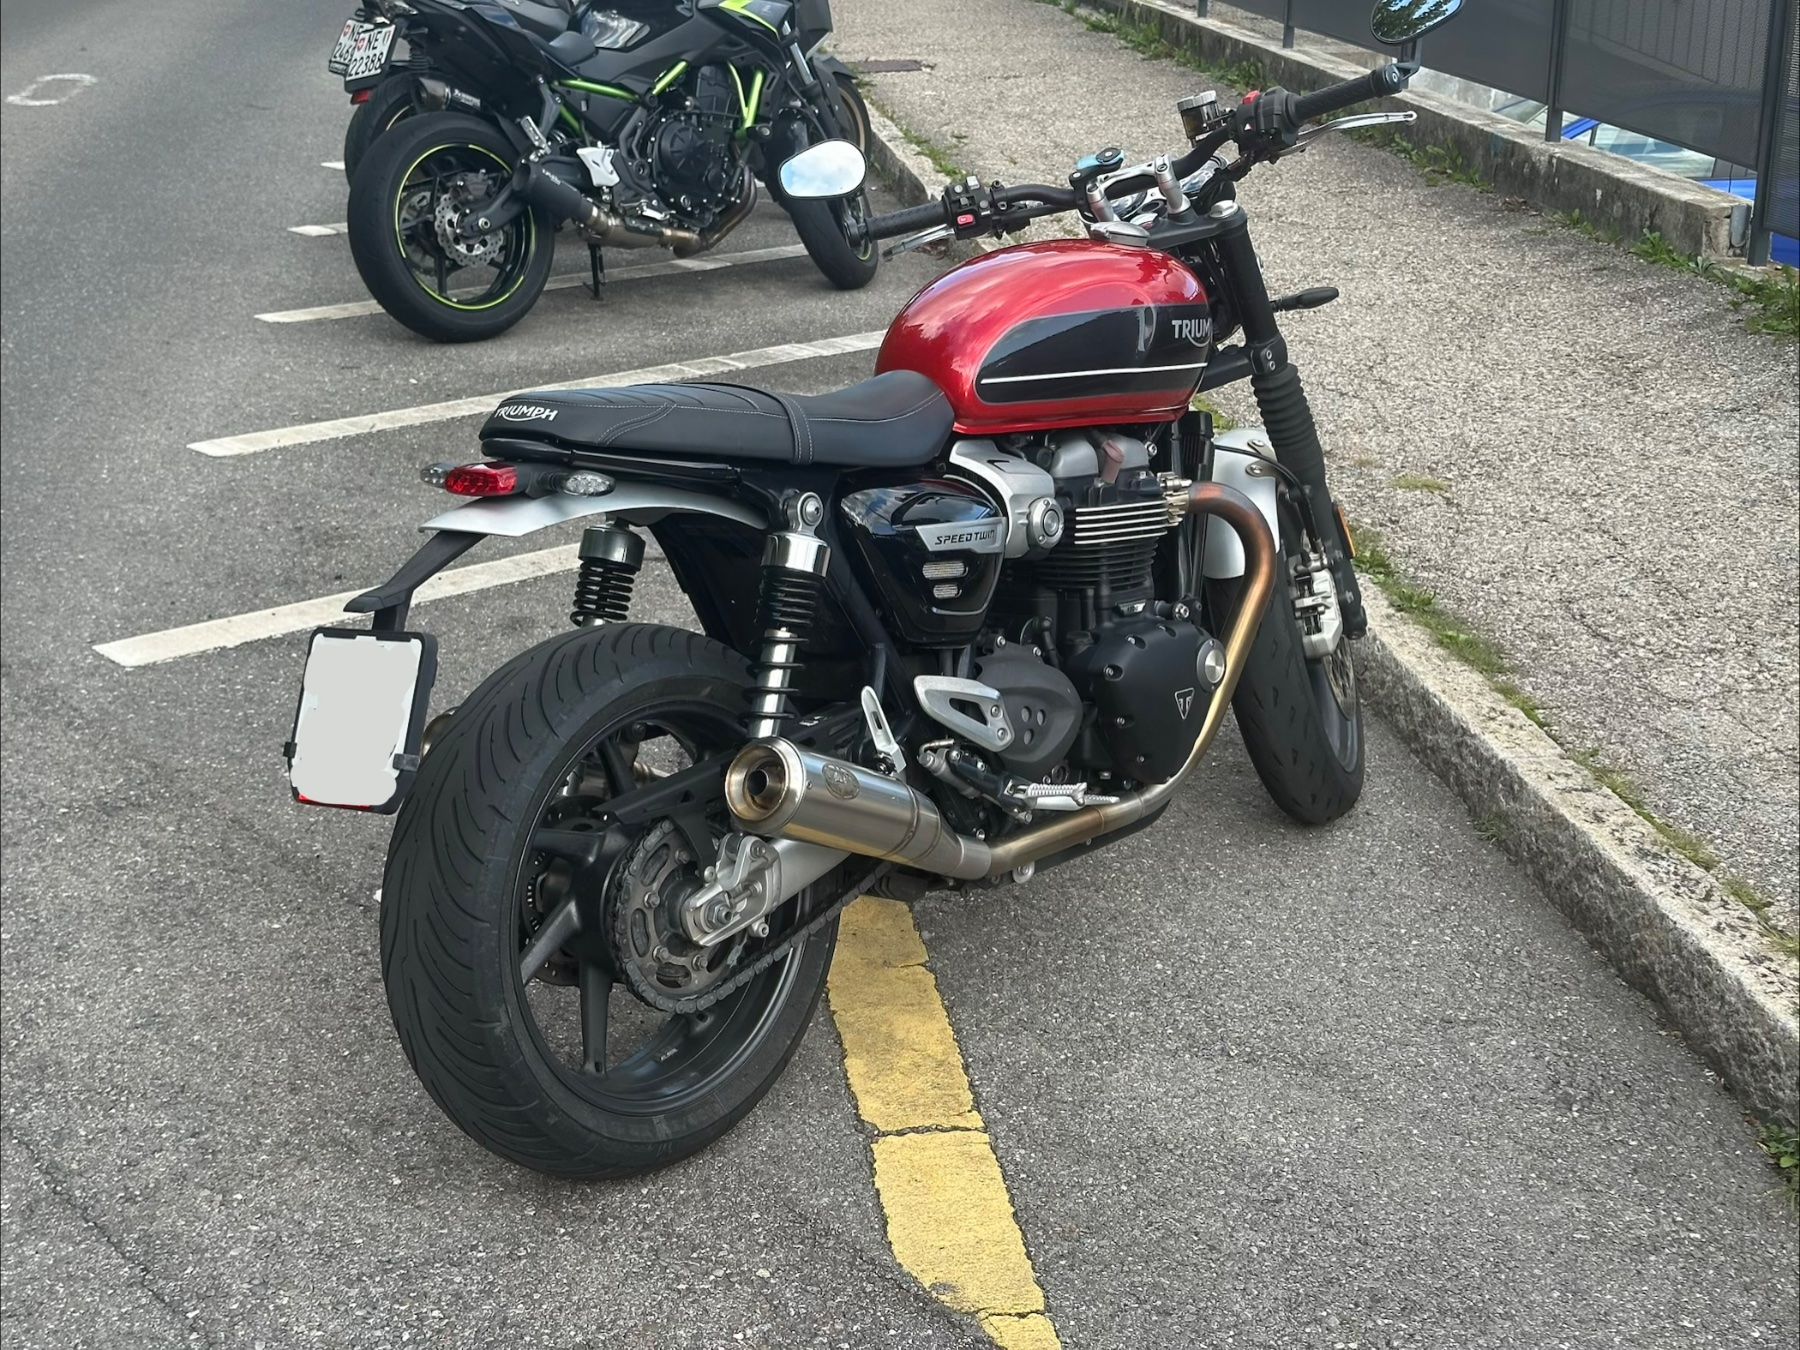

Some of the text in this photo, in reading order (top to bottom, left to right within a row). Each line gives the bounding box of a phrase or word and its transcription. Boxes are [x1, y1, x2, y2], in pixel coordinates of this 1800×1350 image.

[364, 30, 383, 52] NE
[348, 52, 384, 77] 22388
[1171, 317, 1213, 348] TRIUM
[494, 404, 559, 421] TRIUMPH
